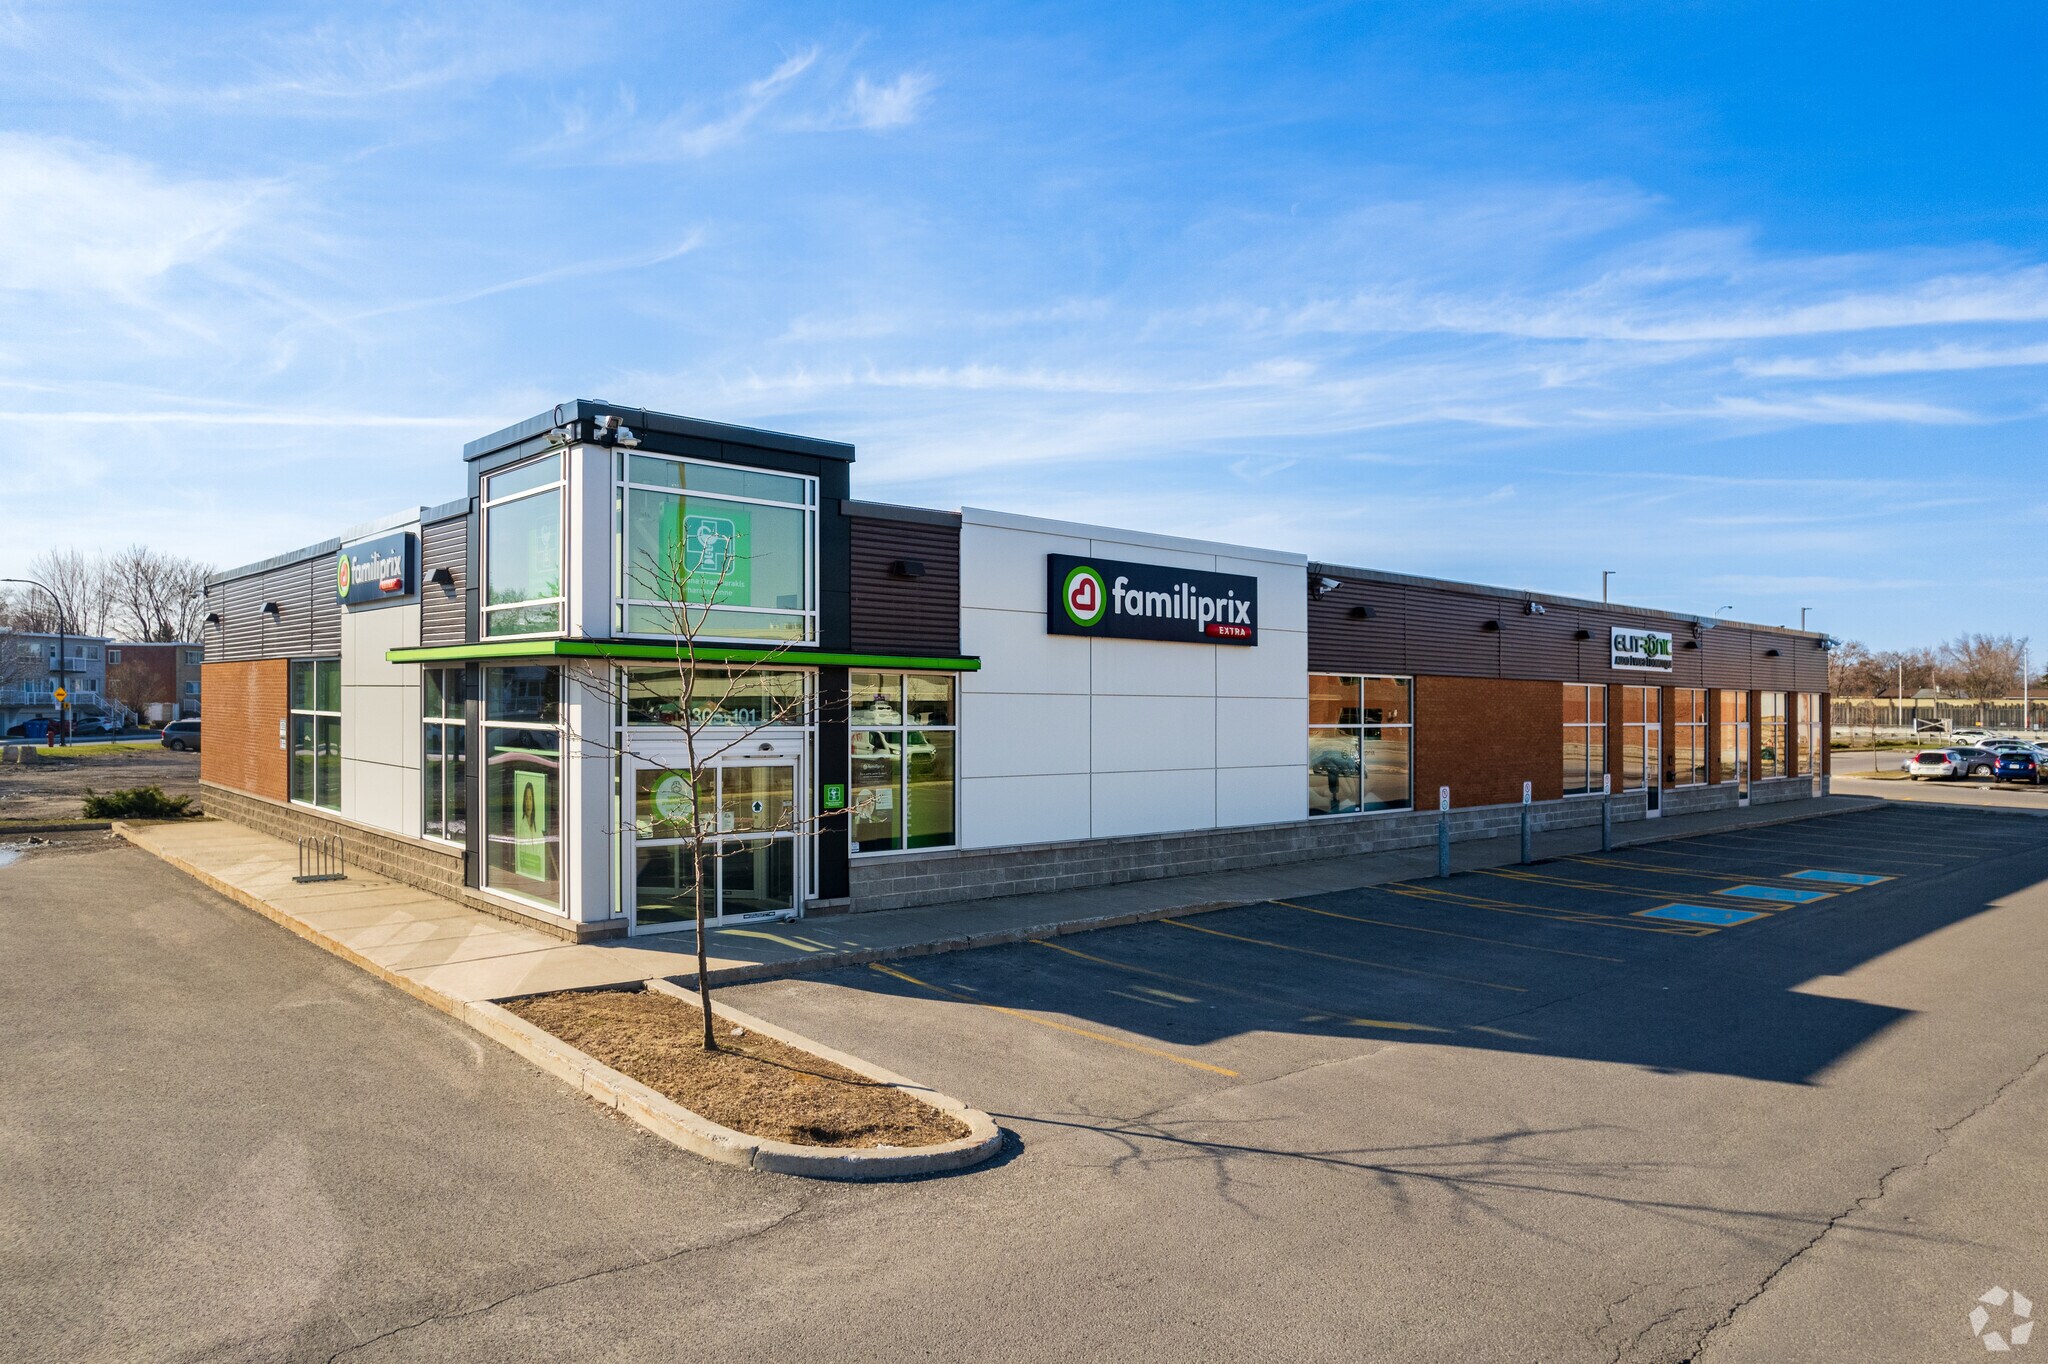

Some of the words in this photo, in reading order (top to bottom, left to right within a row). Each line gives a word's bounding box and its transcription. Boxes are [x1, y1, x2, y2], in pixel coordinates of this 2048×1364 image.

[351, 549, 401, 585] familiprix
[1112, 576, 1251, 633] familiprix
[1218, 626, 1246, 636] EXTRA
